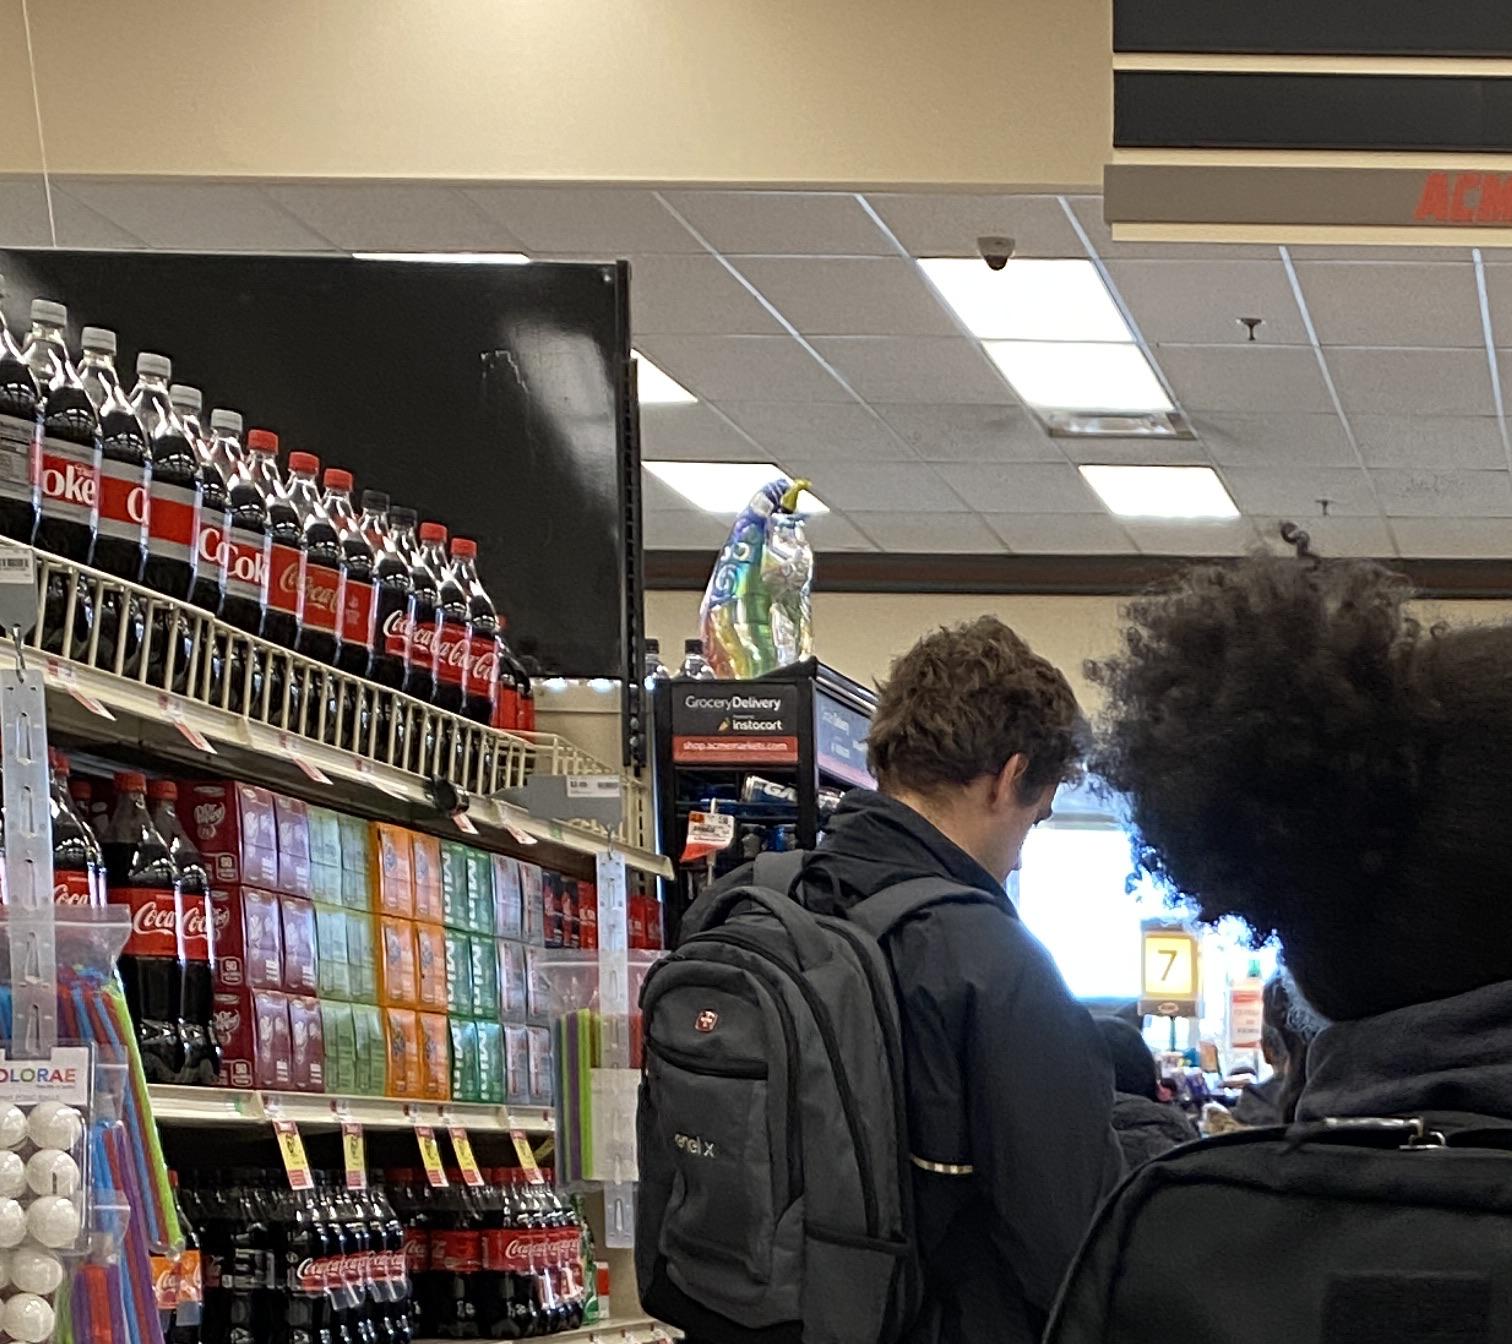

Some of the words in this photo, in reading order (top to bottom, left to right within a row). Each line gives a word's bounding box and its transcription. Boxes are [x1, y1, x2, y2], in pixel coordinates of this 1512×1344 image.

[42, 465, 98, 506] oke
[1157, 949, 1178, 982] 7
[0, 1067, 77, 1083] OLORAE
